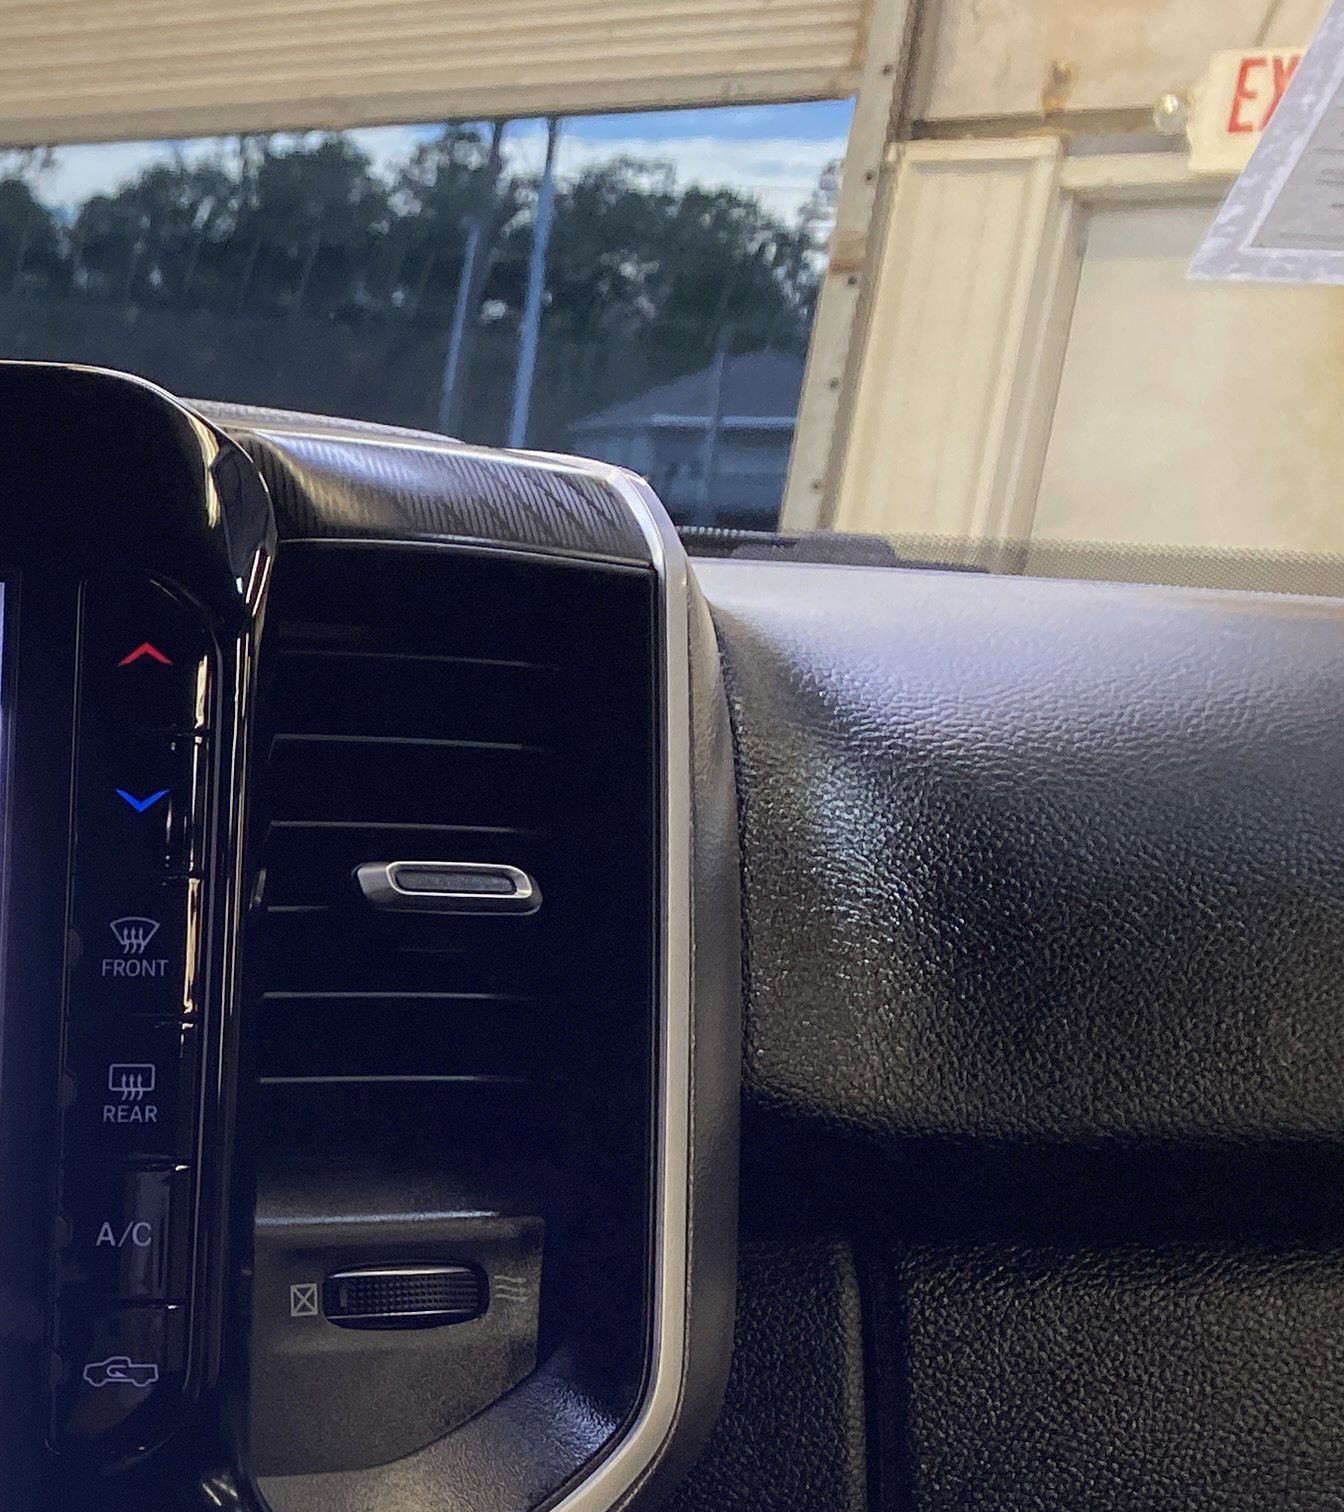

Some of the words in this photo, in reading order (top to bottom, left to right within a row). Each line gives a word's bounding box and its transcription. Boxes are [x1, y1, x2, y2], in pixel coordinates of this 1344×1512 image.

[1227, 55, 1302, 133] EX
[102, 959, 169, 977] FRONT
[103, 1105, 158, 1123] REAR
[96, 1221, 152, 1247] A/C
